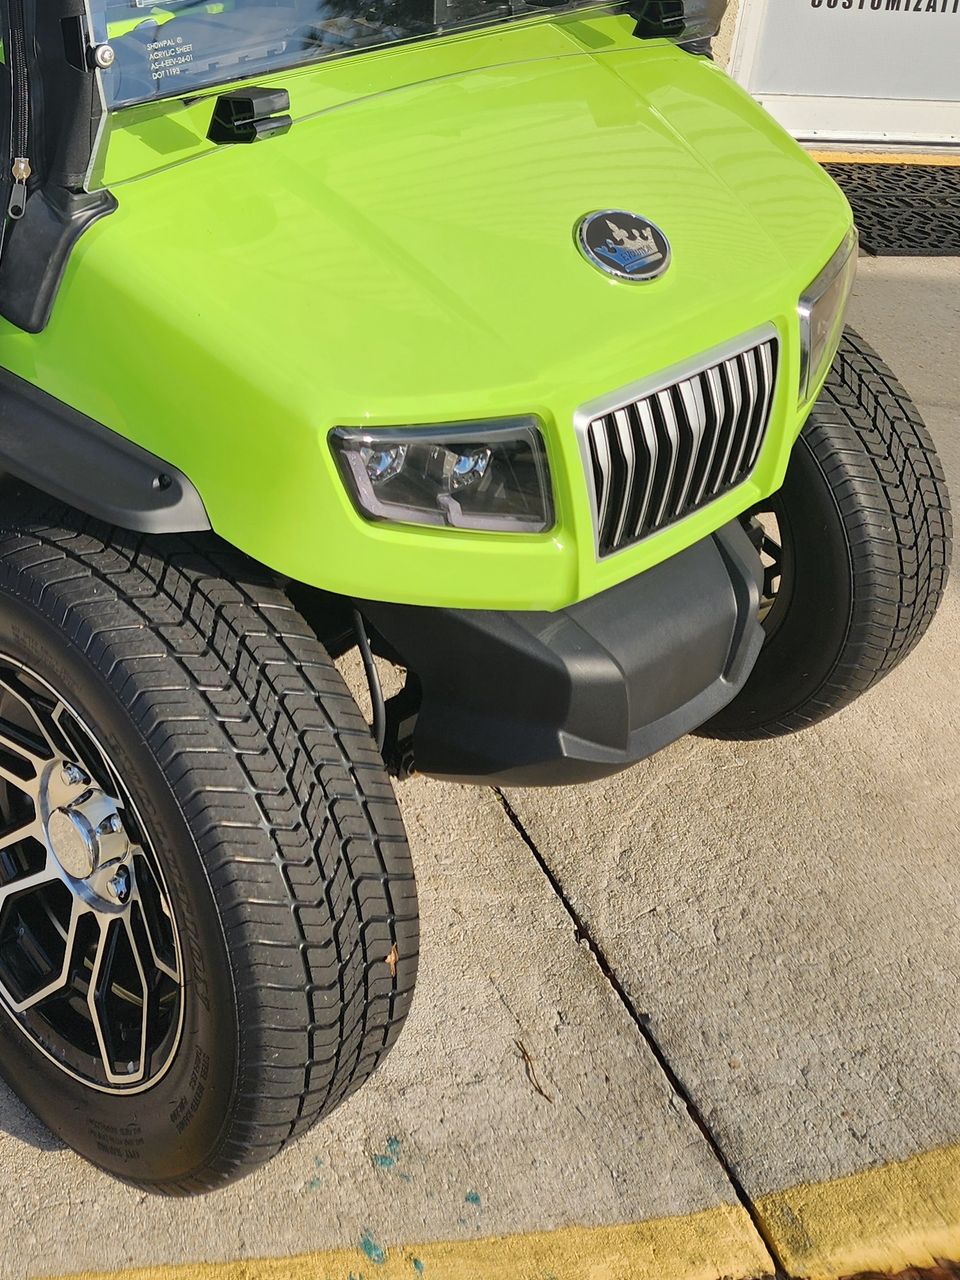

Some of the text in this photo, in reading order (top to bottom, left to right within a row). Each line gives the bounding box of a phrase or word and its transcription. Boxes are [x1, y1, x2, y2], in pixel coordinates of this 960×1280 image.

[149, 44, 192, 60] ACRYLIC SHEET
[152, 70, 165, 80] DOT
